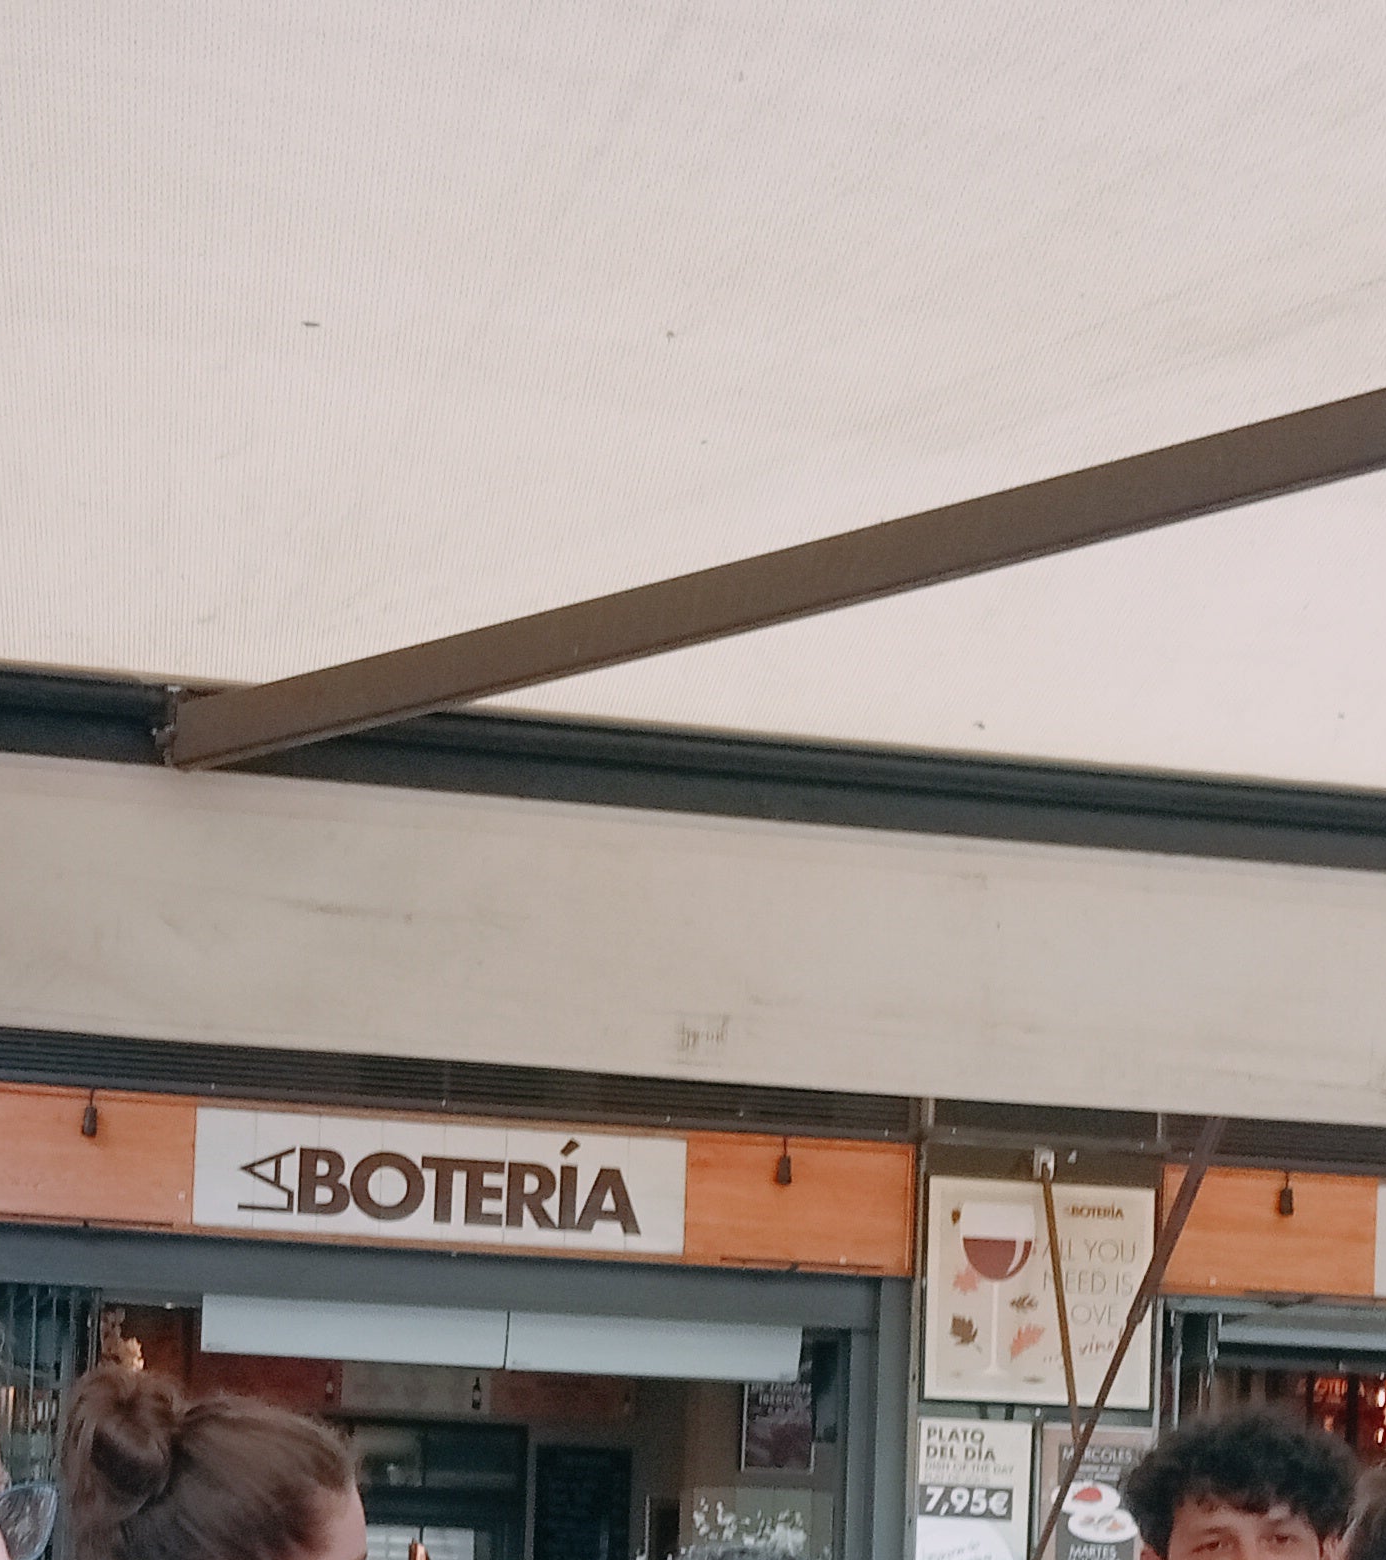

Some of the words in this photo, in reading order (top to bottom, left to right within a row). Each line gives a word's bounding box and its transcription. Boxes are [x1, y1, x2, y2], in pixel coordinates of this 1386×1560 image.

[297, 1138, 641, 1237] BOTERÍA
[1084, 1238, 1137, 1263] YOU
[1068, 1302, 1118, 1328] OVE
[926, 1427, 985, 1443] PLATO
[926, 1446, 954, 1459] DEL
[1062, 1446, 1133, 1464] MRCOLES
[924, 1486, 1010, 1518] 7,95€
[1069, 1544, 1117, 1560] MARTES
